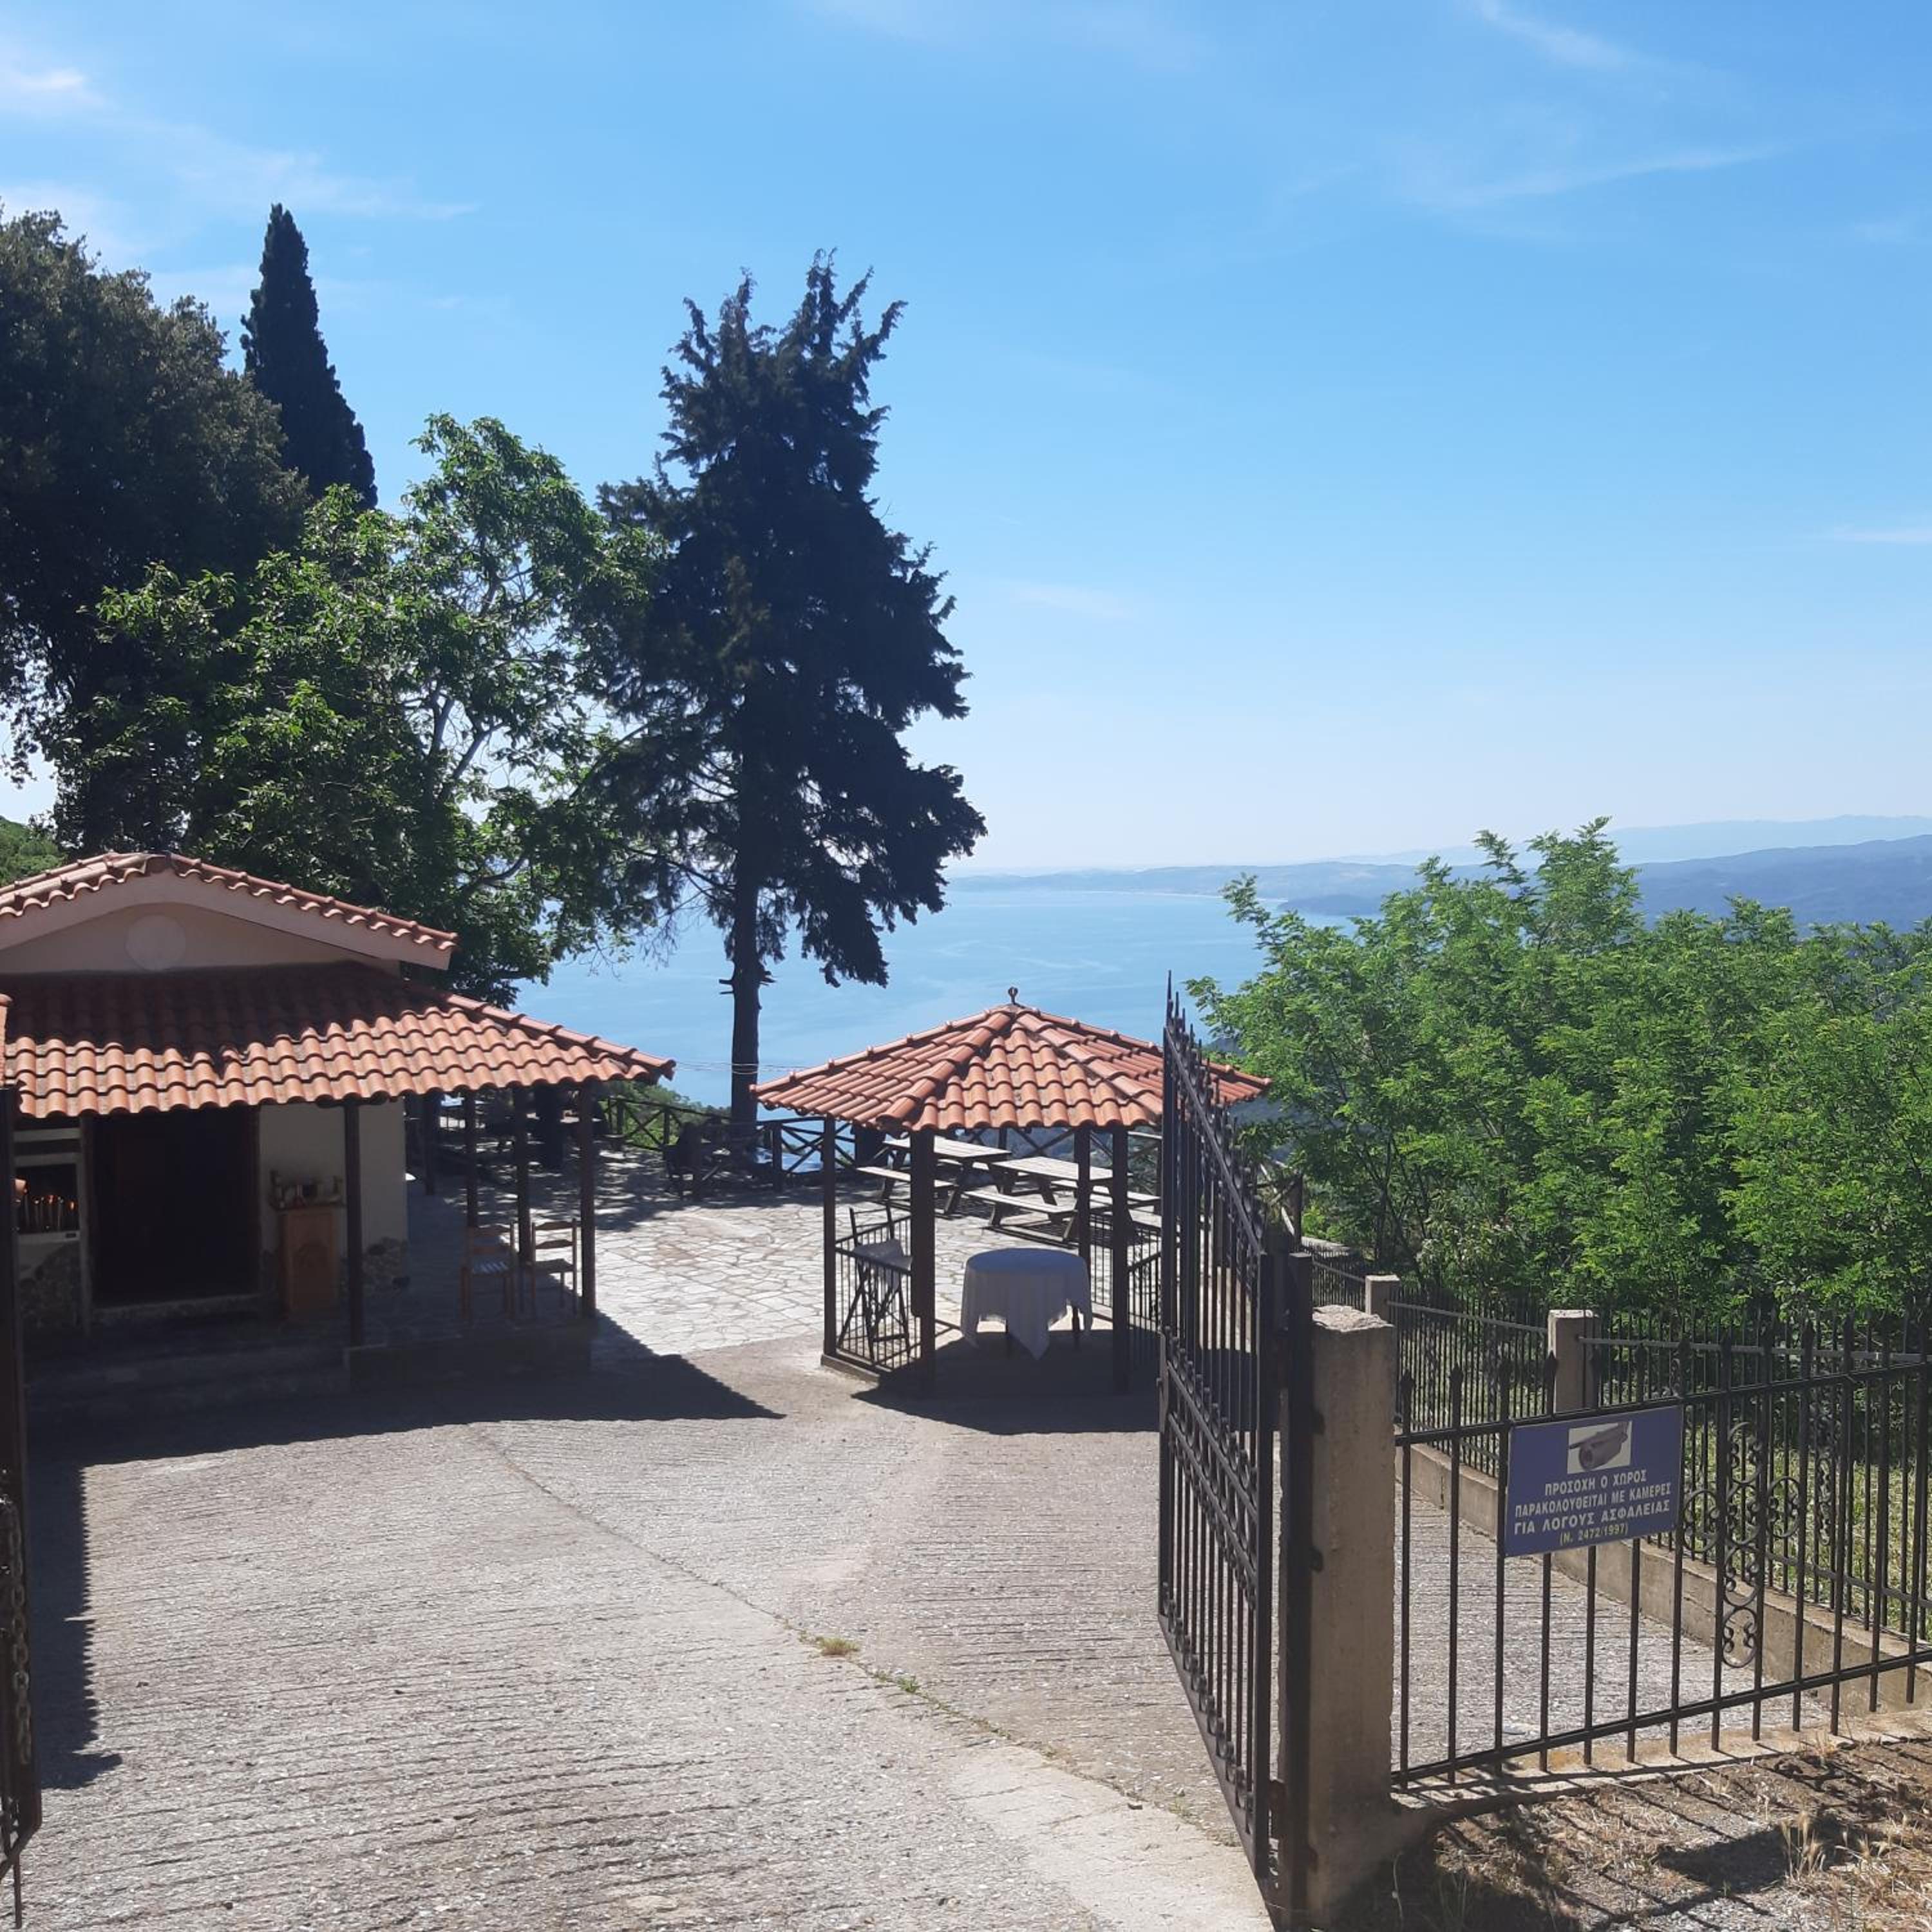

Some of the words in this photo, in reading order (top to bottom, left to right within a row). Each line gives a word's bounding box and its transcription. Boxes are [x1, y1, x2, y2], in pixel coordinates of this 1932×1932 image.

[1515, 1492, 1607, 1518] ΠΑΡΑΚΟΛΟΥΘΕΙΤΑΙ
[1611, 1489, 1625, 1504] ΜΕ
[1629, 1482, 1671, 1501] ΚΑΜΕΡΕΣ
[1545, 1479, 1596, 1496] ΠΡΟΣΟΧΗ
[1600, 1476, 1608, 1489] Ο
[1613, 1469, 1647, 1486] ΧΩΡΟΣ
[1515, 1521, 1535, 1535] ΓΙΑ
[1542, 1512, 1595, 1532] ΛΟΓΟΥΣ
[1601, 1499, 1670, 1522] ΑΣΦΑΛΕΙΑΣ
